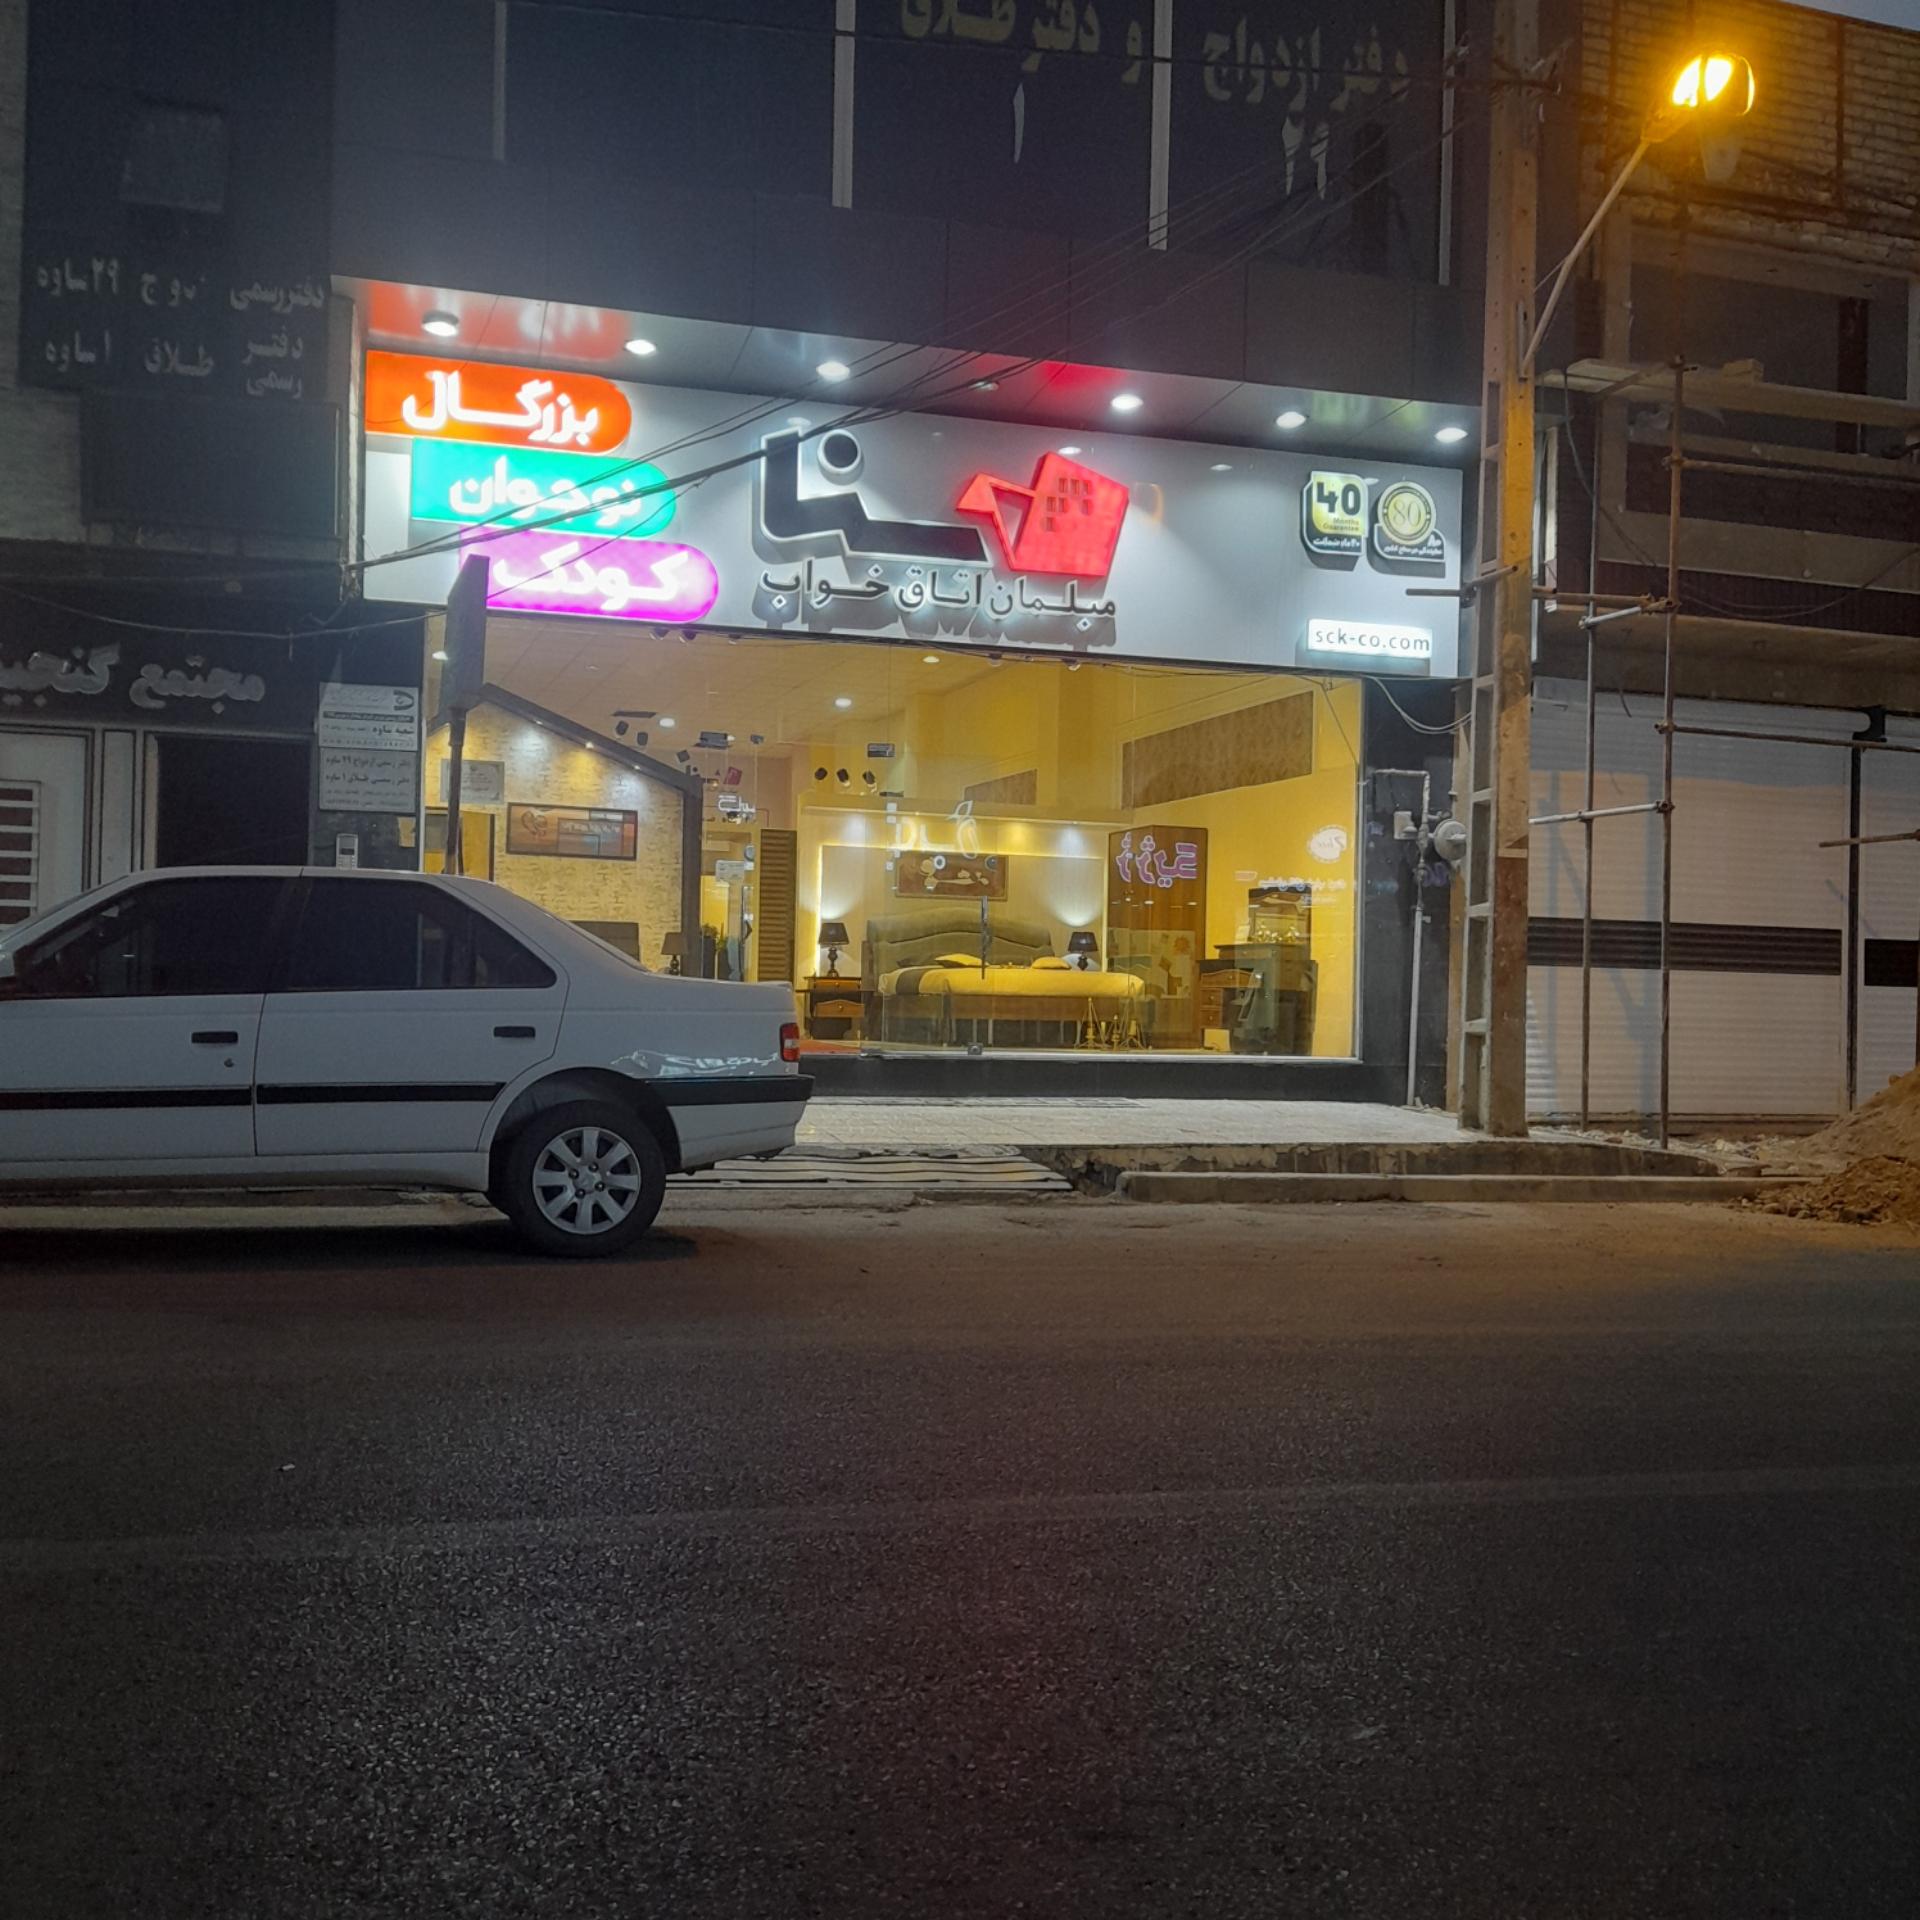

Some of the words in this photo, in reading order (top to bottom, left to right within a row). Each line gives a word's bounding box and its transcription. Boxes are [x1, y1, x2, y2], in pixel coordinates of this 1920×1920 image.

[1120, 19, 1144, 84] و
[1201, 16, 1321, 112] ازدواج
[449, 456, 644, 526] نوجوان
[1316, 481, 1361, 515] 40
[1392, 498, 1423, 528] 80
[494, 542, 689, 610] کودک
[762, 559, 890, 610] خواب
[897, 566, 983, 613] اتاق
[990, 576, 1116, 632] مبلمان
[1316, 628, 1430, 652] sck-co.com
[129, 655, 266, 715] مجتمع
